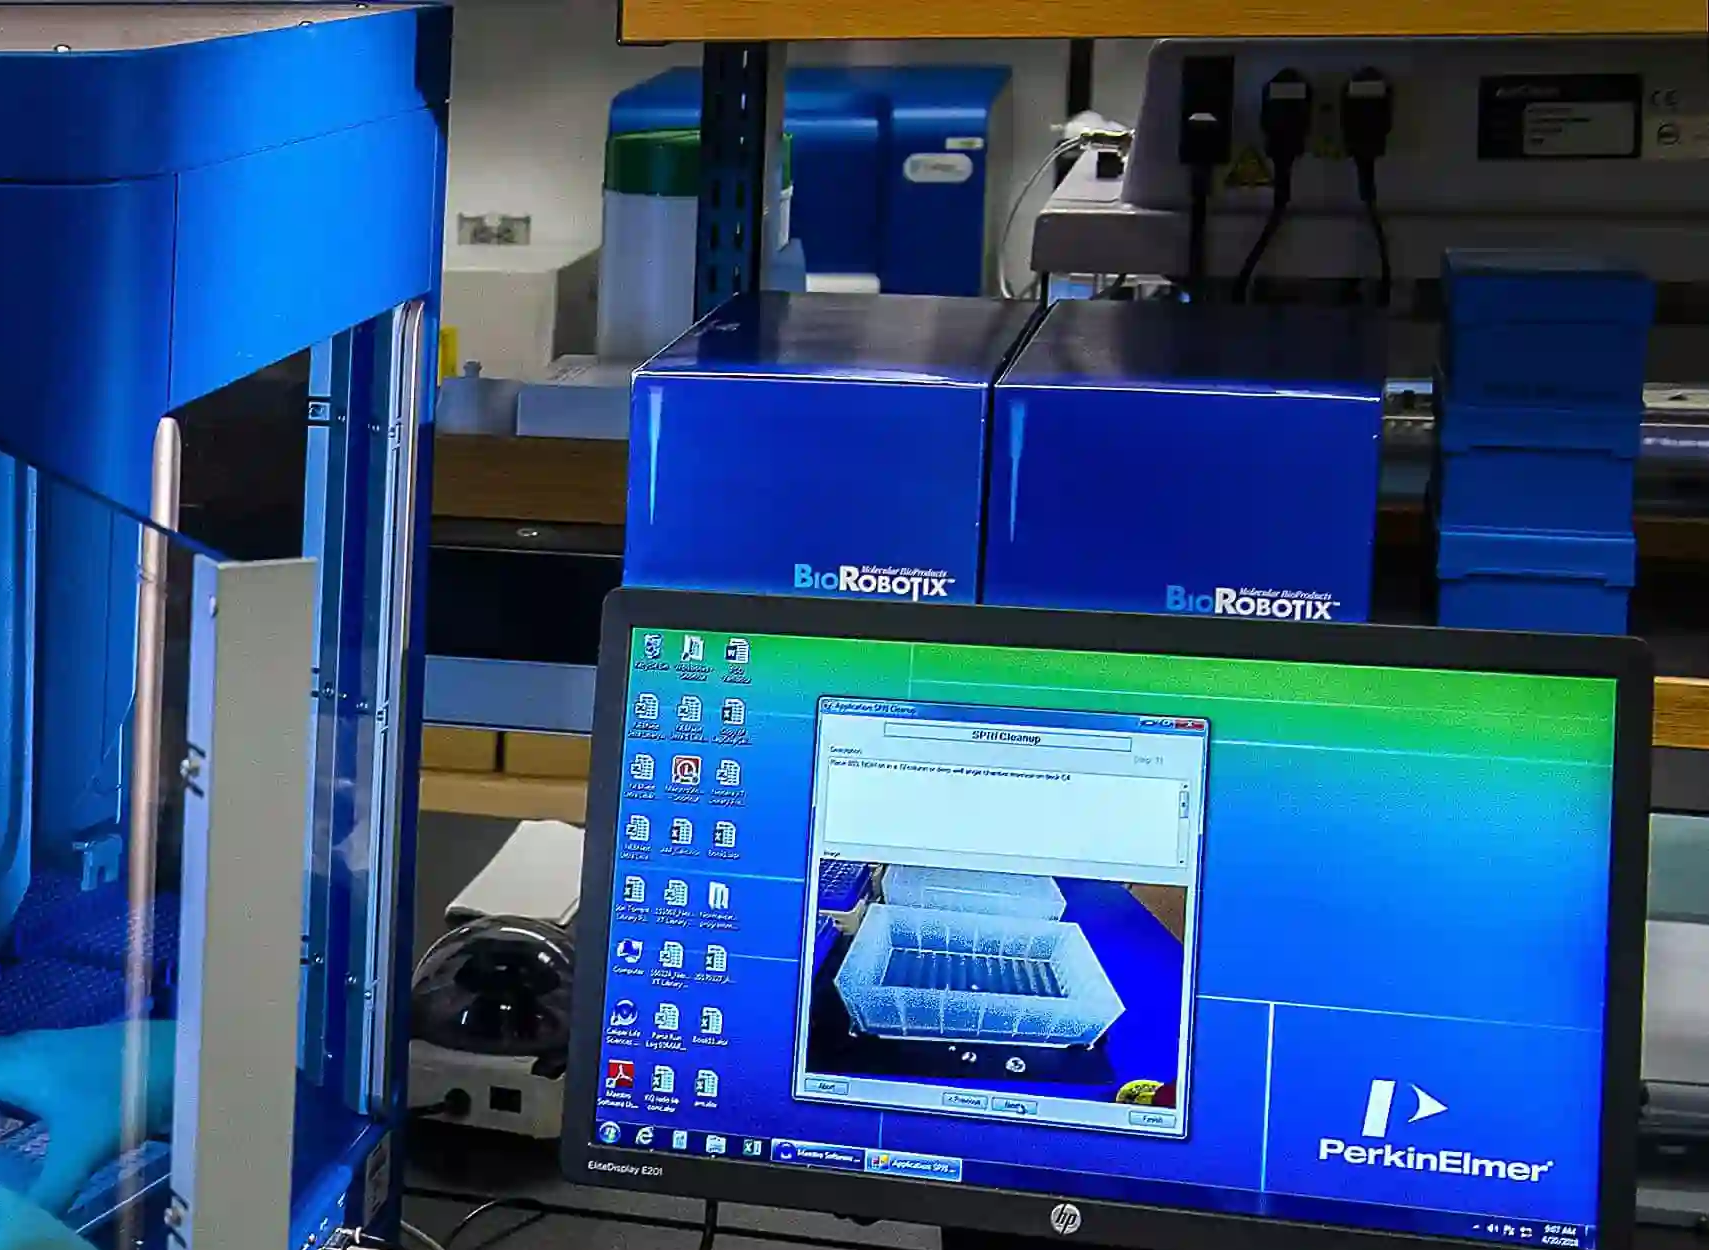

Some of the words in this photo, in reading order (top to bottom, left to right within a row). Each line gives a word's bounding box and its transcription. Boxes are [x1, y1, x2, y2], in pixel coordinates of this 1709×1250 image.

[999, 732, 1041, 745] Cleanup
[587, 1160, 640, 1176] EliteDisplay
[641, 1165, 663, 1176] E201
[1318, 1137, 1551, 1183] PerkinElmer
